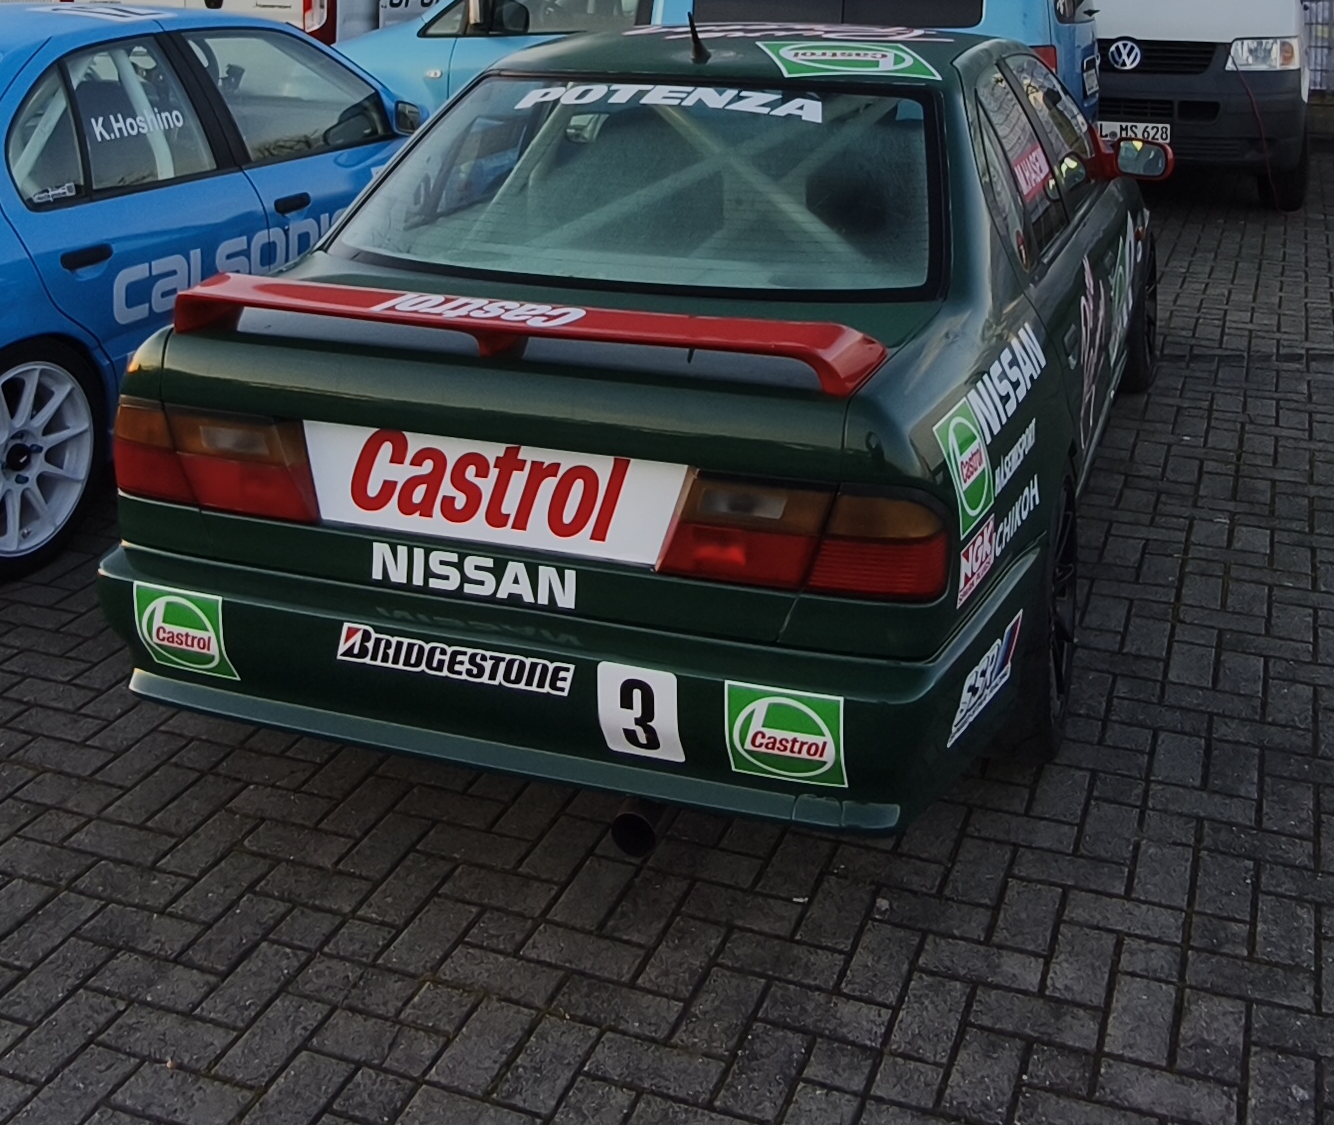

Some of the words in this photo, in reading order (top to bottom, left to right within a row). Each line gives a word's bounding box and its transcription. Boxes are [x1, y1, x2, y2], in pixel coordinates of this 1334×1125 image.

[91, 108, 184, 142] K.Hoshino
[514, 83, 823, 123] POTENZA
[1099, 123, 1108, 138] L
[1119, 124, 1138, 139] MS
[1142, 126, 1169, 141] 628
[371, 292, 587, 328] Castrol
[966, 322, 1047, 445] NISSAN
[350, 428, 631, 542] Castrol
[960, 444, 984, 484] Castrol
[992, 473, 1040, 563] ICHIKOH
[371, 542, 577, 610] NISSAN
[960, 523, 995, 590] NGK
[156, 624, 212, 652] Castrol
[340, 626, 571, 694] BRIDGESTONE
[619, 678, 661, 751] 3
[750, 729, 828, 759] Castrol
